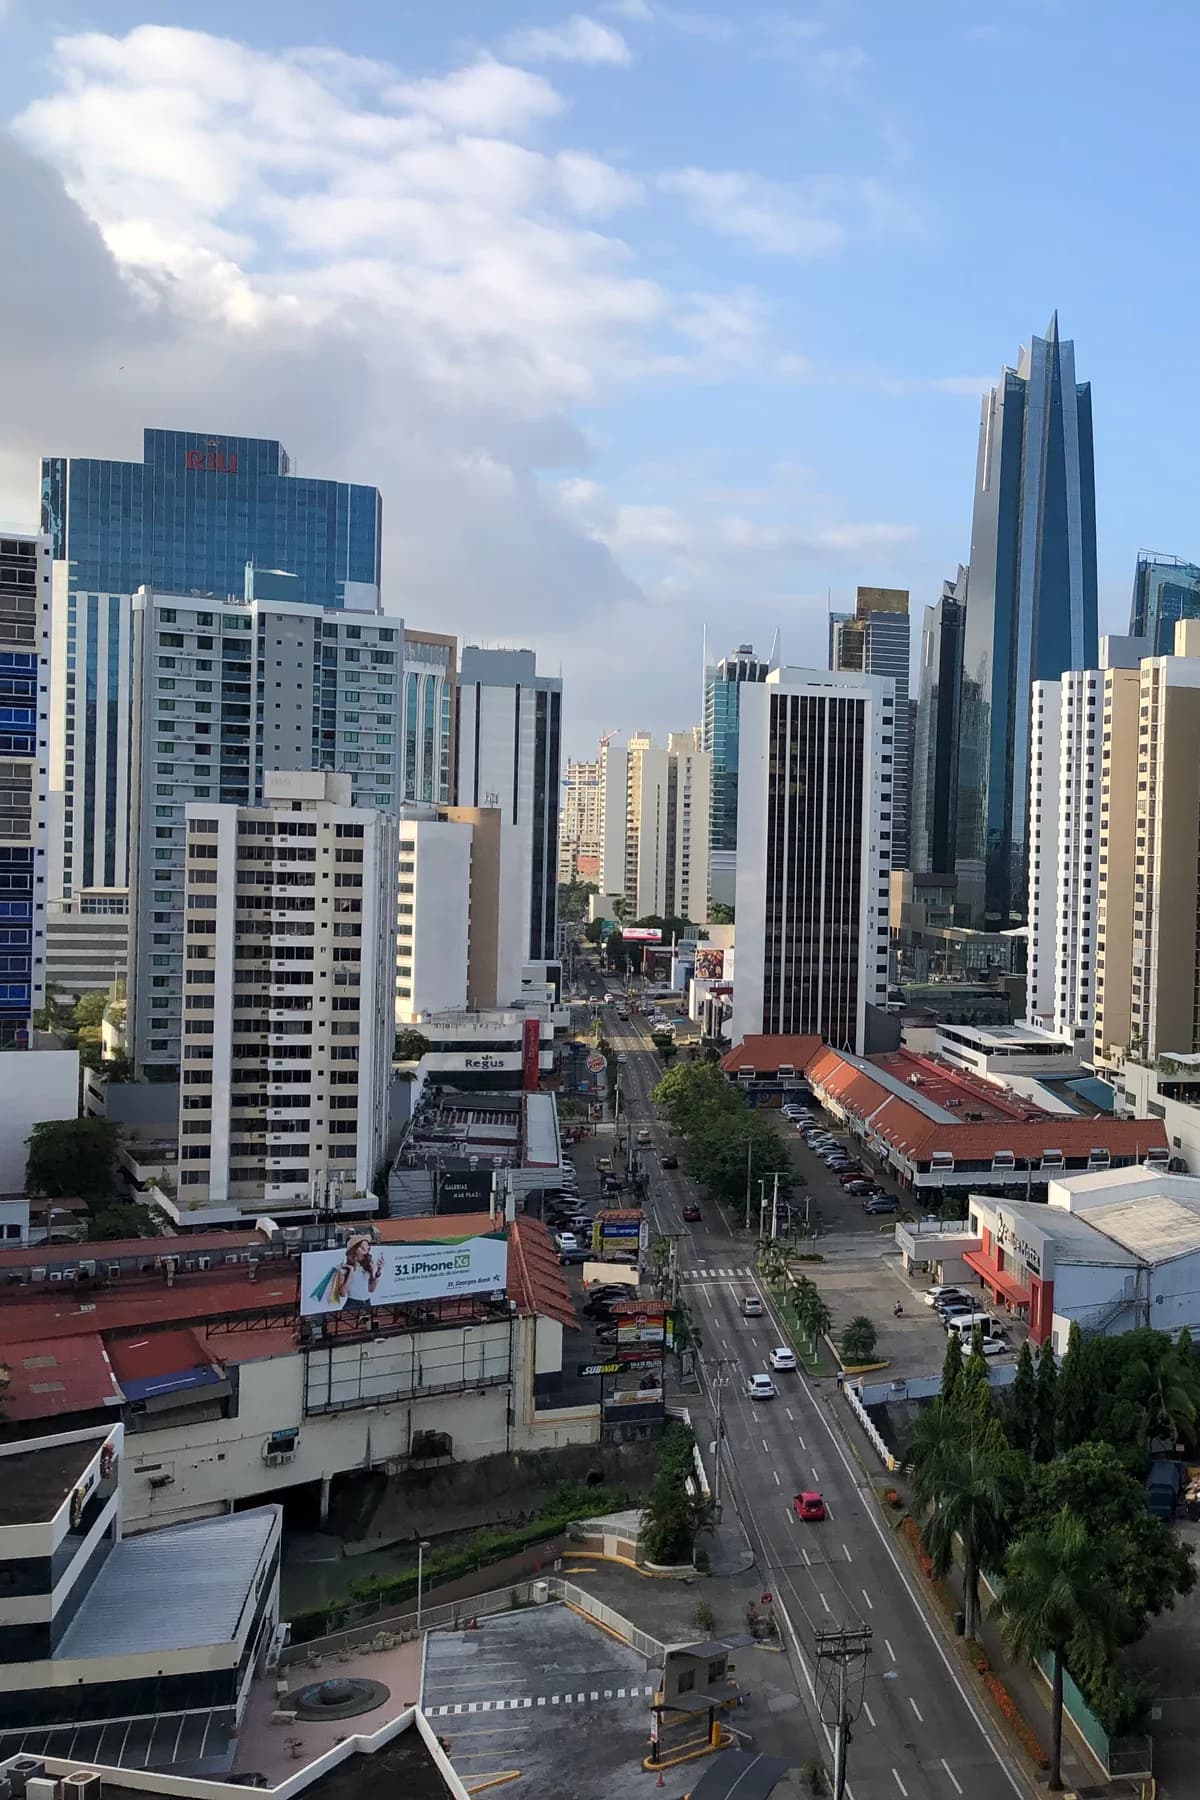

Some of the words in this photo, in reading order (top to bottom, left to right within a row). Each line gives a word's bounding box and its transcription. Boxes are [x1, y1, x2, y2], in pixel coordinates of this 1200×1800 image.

[186, 449, 238, 472] RIU
[465, 1058, 504, 1070] Regus
[394, 1264, 409, 1276] 31
[411, 1261, 453, 1274] iPhone
[582, 1363, 623, 1375] SUBWAY
